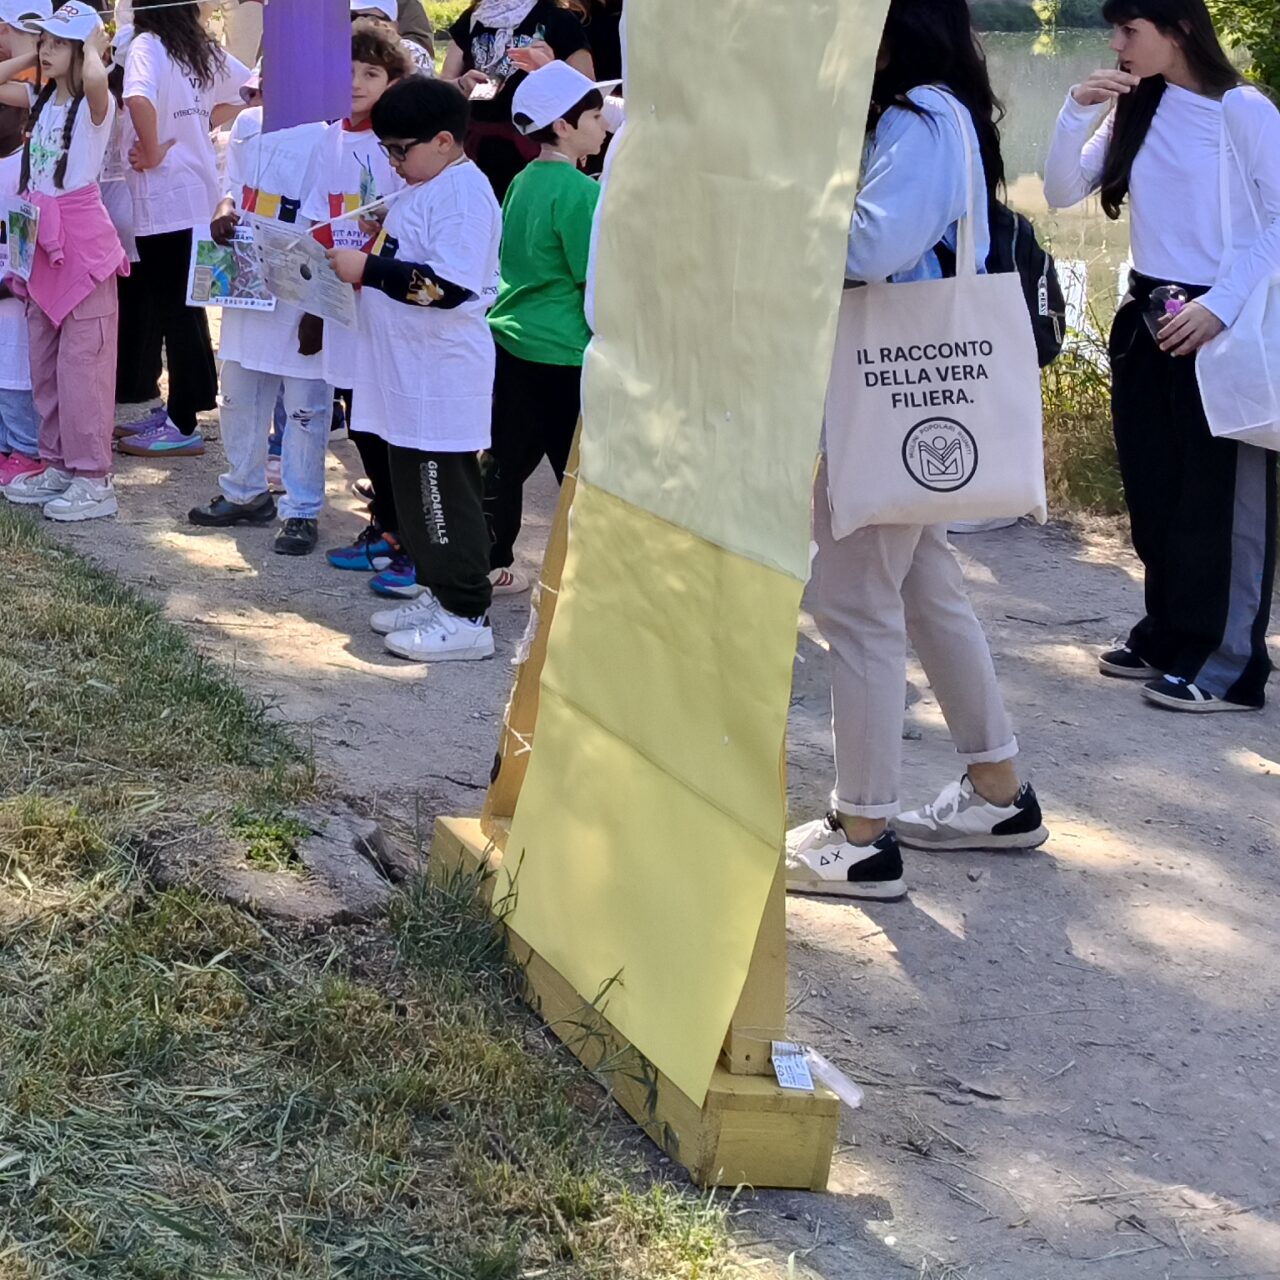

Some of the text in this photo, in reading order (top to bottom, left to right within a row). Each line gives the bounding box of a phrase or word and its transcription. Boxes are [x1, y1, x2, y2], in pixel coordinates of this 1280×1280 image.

[856, 340, 993, 365] IL RACCONTO
[864, 363, 989, 387] DELLA VERA
[891, 388, 975, 408] FILIERA.
[919, 423, 956, 435] POPOLARI
[427, 460, 449, 545] GRAND&HILLS
